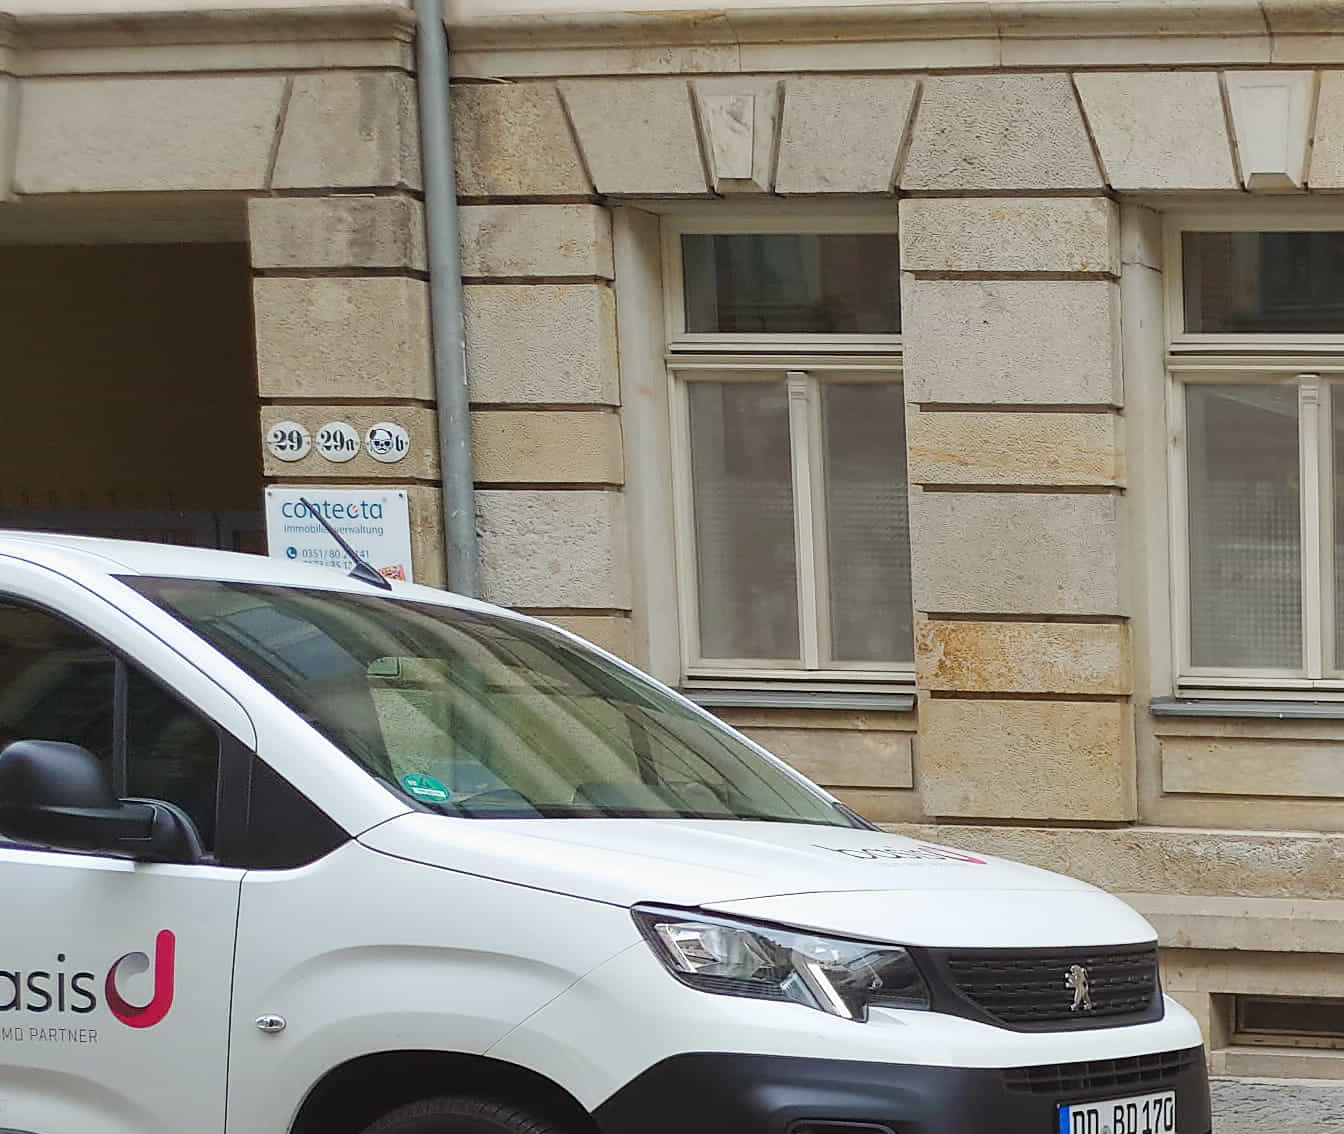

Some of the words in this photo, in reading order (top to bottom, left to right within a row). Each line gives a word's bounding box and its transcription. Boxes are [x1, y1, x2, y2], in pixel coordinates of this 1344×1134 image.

[272, 429, 303, 451] 29
[320, 430, 355, 451] 29a
[281, 499, 383, 519] contecta
[29, 1027, 98, 1043] PARTNER
